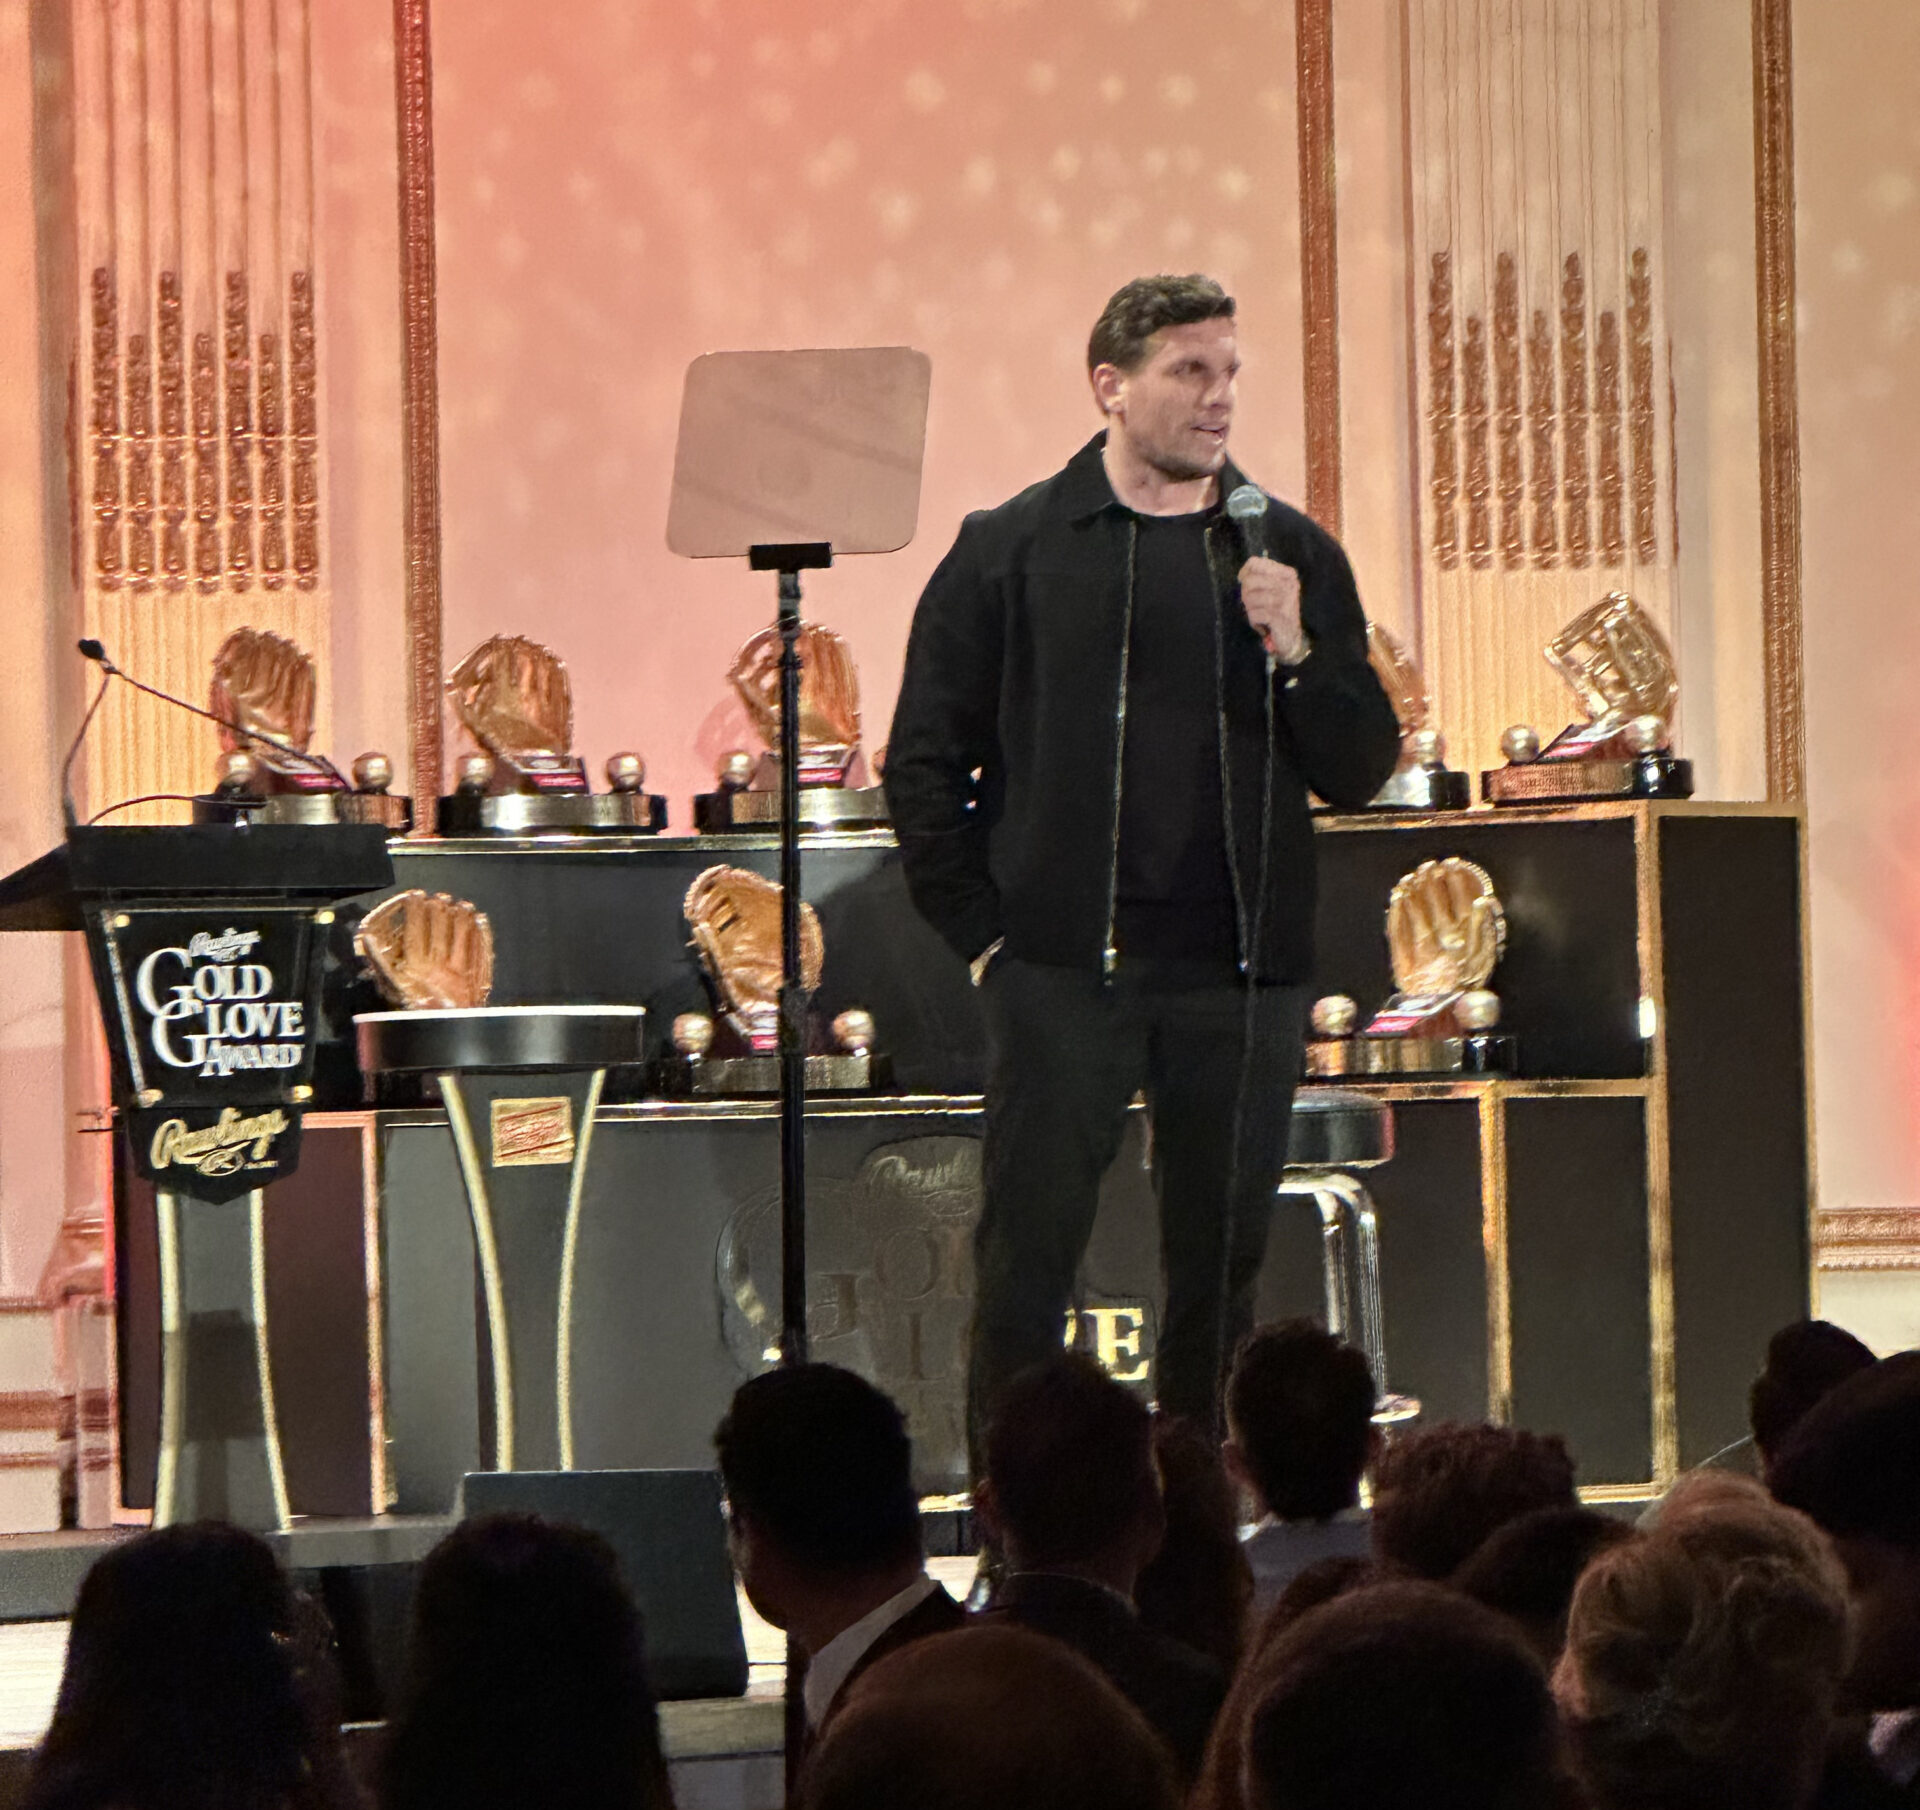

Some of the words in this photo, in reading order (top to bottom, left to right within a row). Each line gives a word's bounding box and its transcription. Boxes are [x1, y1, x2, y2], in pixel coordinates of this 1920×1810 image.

[137, 948, 273, 1020] GOLD
[152, 999, 305, 1068] GLOVE
[199, 1044, 305, 1077] AWARD
